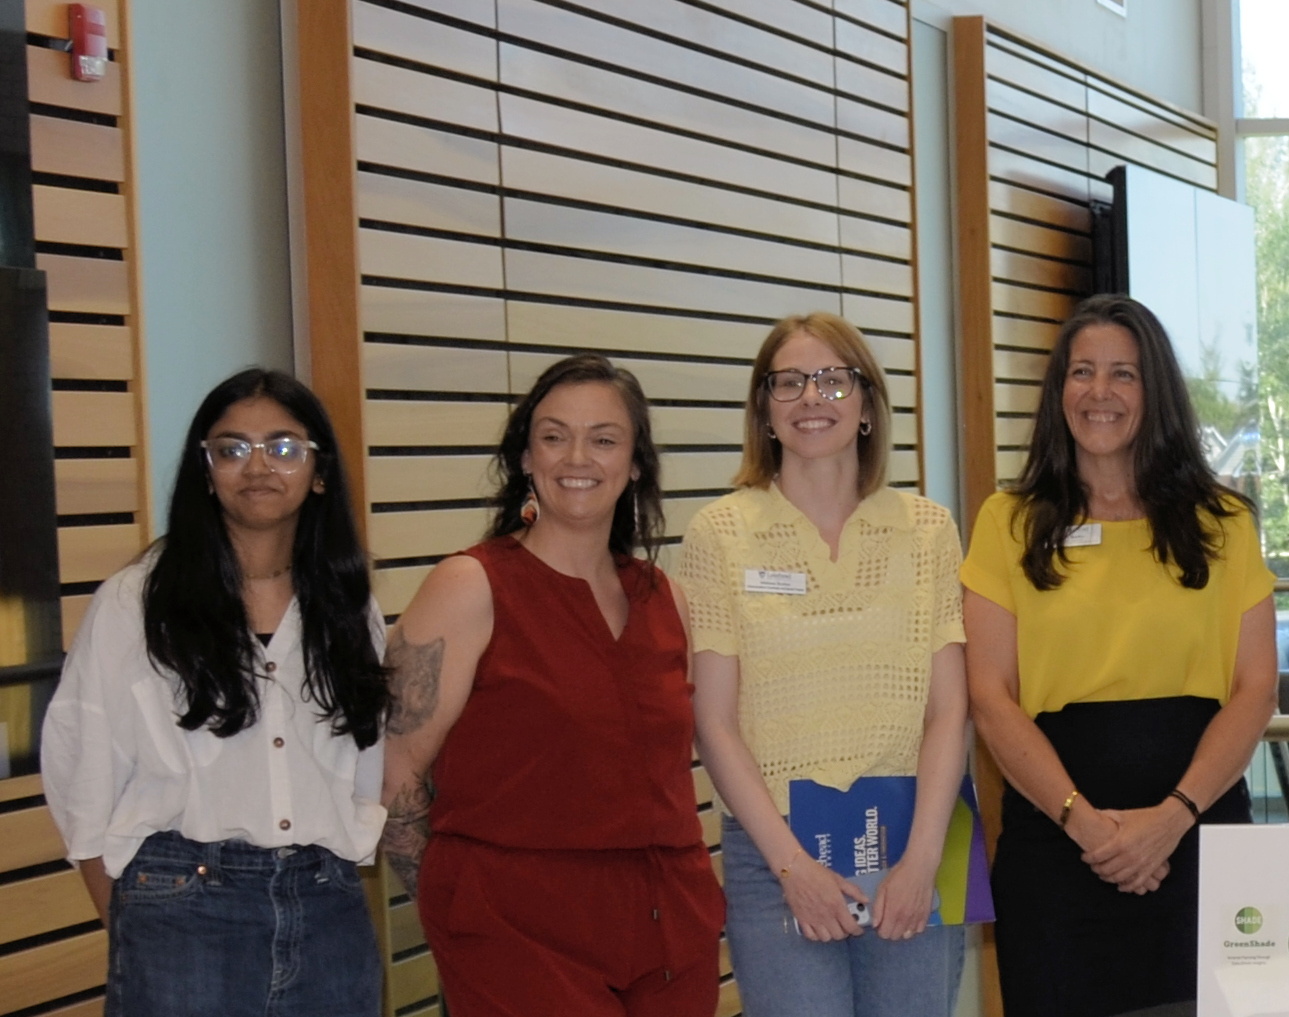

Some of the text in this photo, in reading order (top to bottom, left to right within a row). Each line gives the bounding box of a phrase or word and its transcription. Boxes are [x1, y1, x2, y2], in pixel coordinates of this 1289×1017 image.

[865, 806, 878, 846] WORLD.
[854, 834, 866, 867] IDEAS.
[1223, 940, 1276, 948] GreenShade
